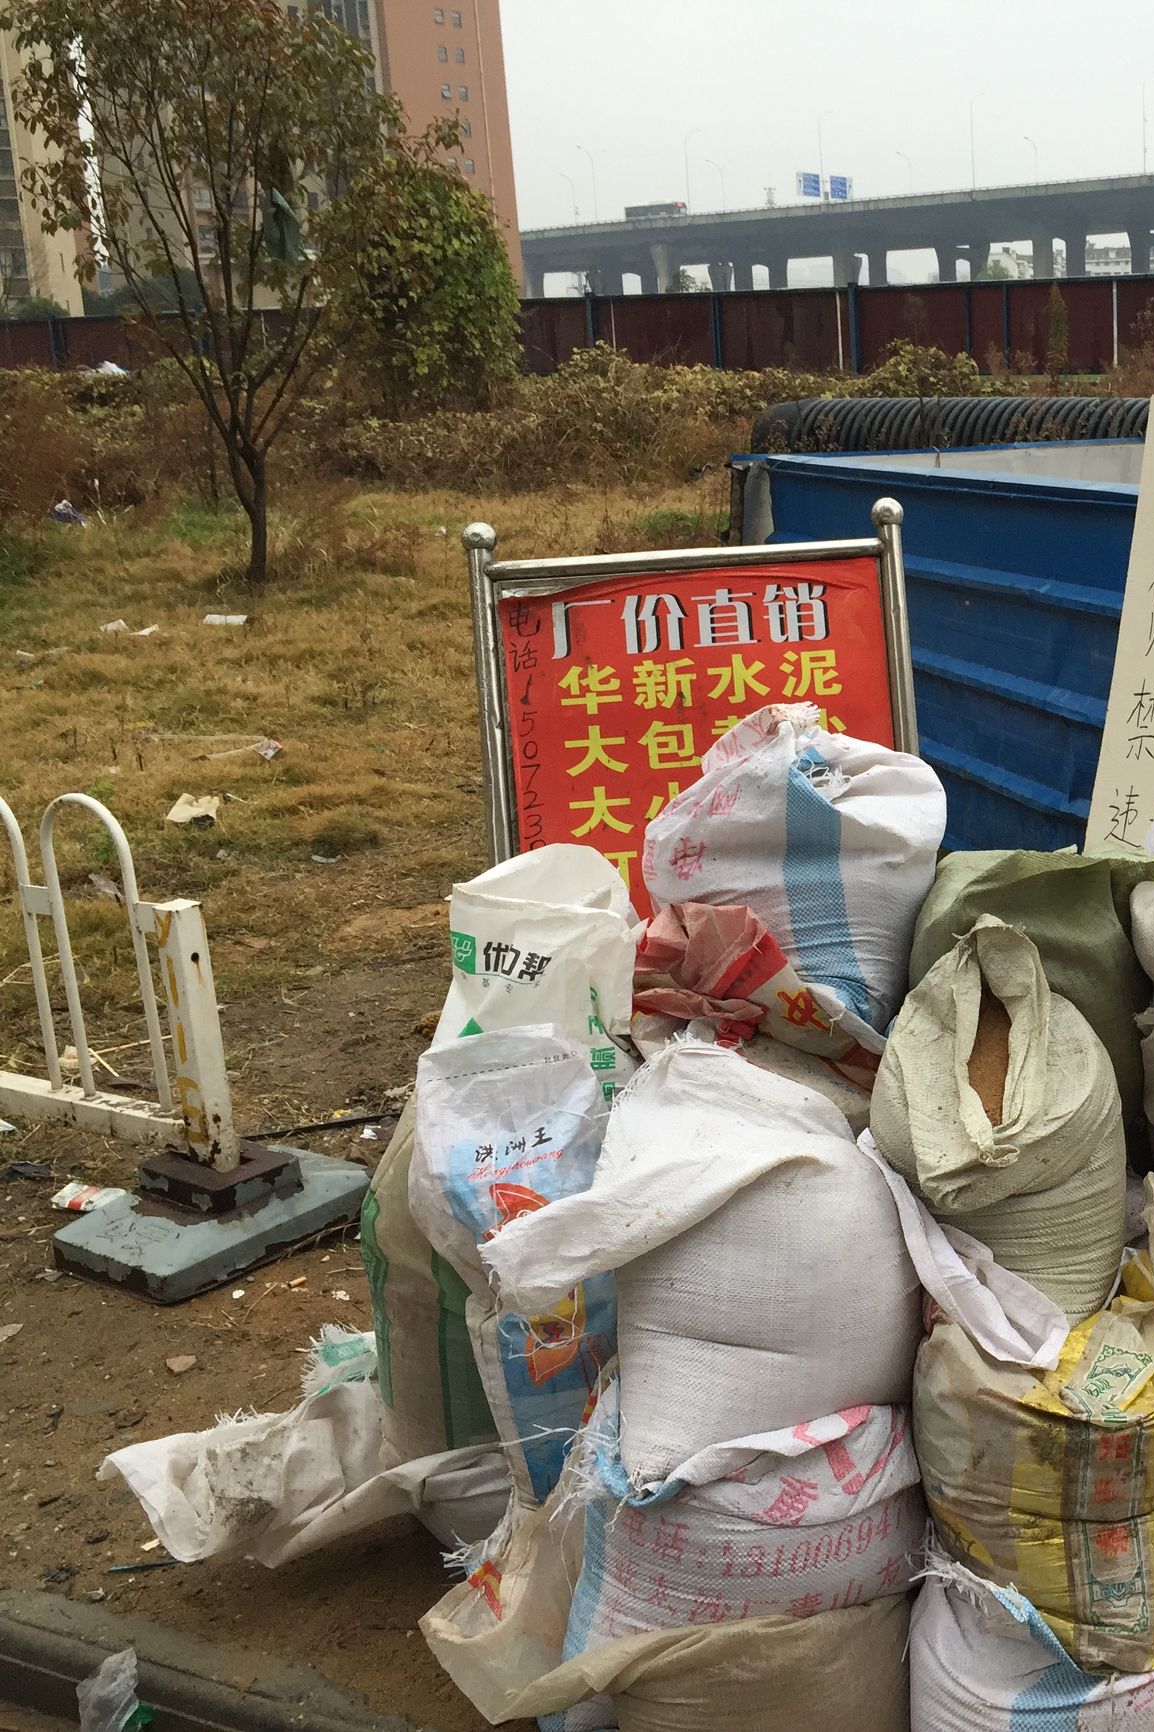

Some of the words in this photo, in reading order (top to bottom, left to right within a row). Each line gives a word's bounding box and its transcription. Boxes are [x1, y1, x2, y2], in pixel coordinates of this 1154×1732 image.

[552, 583, 828, 660] 厂价直销
[559, 650, 842, 714] 华新水泥
[564, 708, 847, 777] 大包
